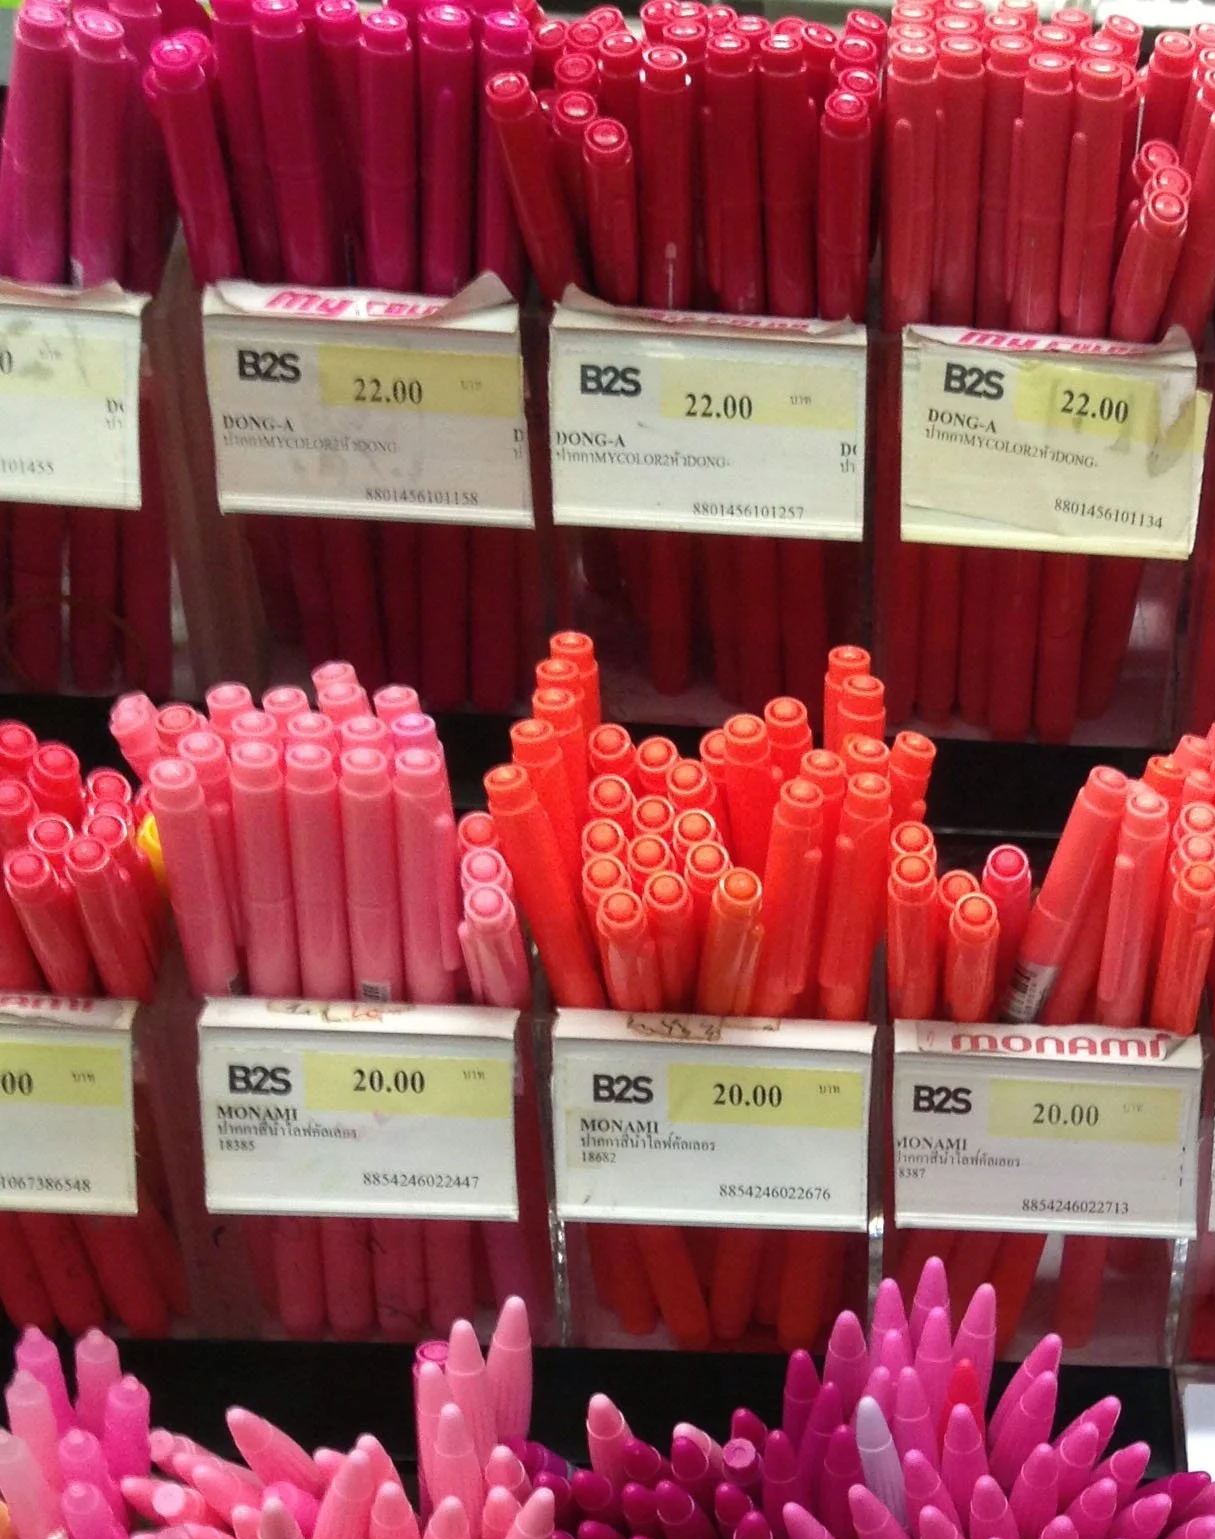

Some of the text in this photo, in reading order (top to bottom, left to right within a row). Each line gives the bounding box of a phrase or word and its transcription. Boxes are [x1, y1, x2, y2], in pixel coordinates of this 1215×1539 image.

[238, 350, 301, 383] B2S
[354, 378, 423, 404] 22.00
[580, 364, 641, 396] B2S
[685, 394, 752, 419] 22.00
[944, 362, 1129, 424] B2S 22.00
[223, 415, 294, 433] DONG-A
[928, 408, 997, 434] DONG-A
[556, 431, 625, 448] DONG-A
[693, 502, 804, 520] 8801456101257
[1054, 497, 1163, 529] 8801456101134
[229, 1064, 291, 1095] B2S
[353, 1069, 425, 1093] 20.00
[593, 1074, 653, 1104] B2S
[713, 1083, 782, 1107] 20.00
[217, 1106, 298, 1122] MONAMI
[913, 1085, 972, 1114] B2S
[1032, 1103, 1099, 1126] 20.00
[580, 1119, 658, 1133] MONAMI
[219, 1139, 255, 1151] 18385
[581, 1151, 616, 1163] 18682
[363, 1173, 479, 1188] 8854246022447
[719, 1184, 831, 1200] 8854246022676
[1022, 1199, 1129, 1214] 8854246022713
